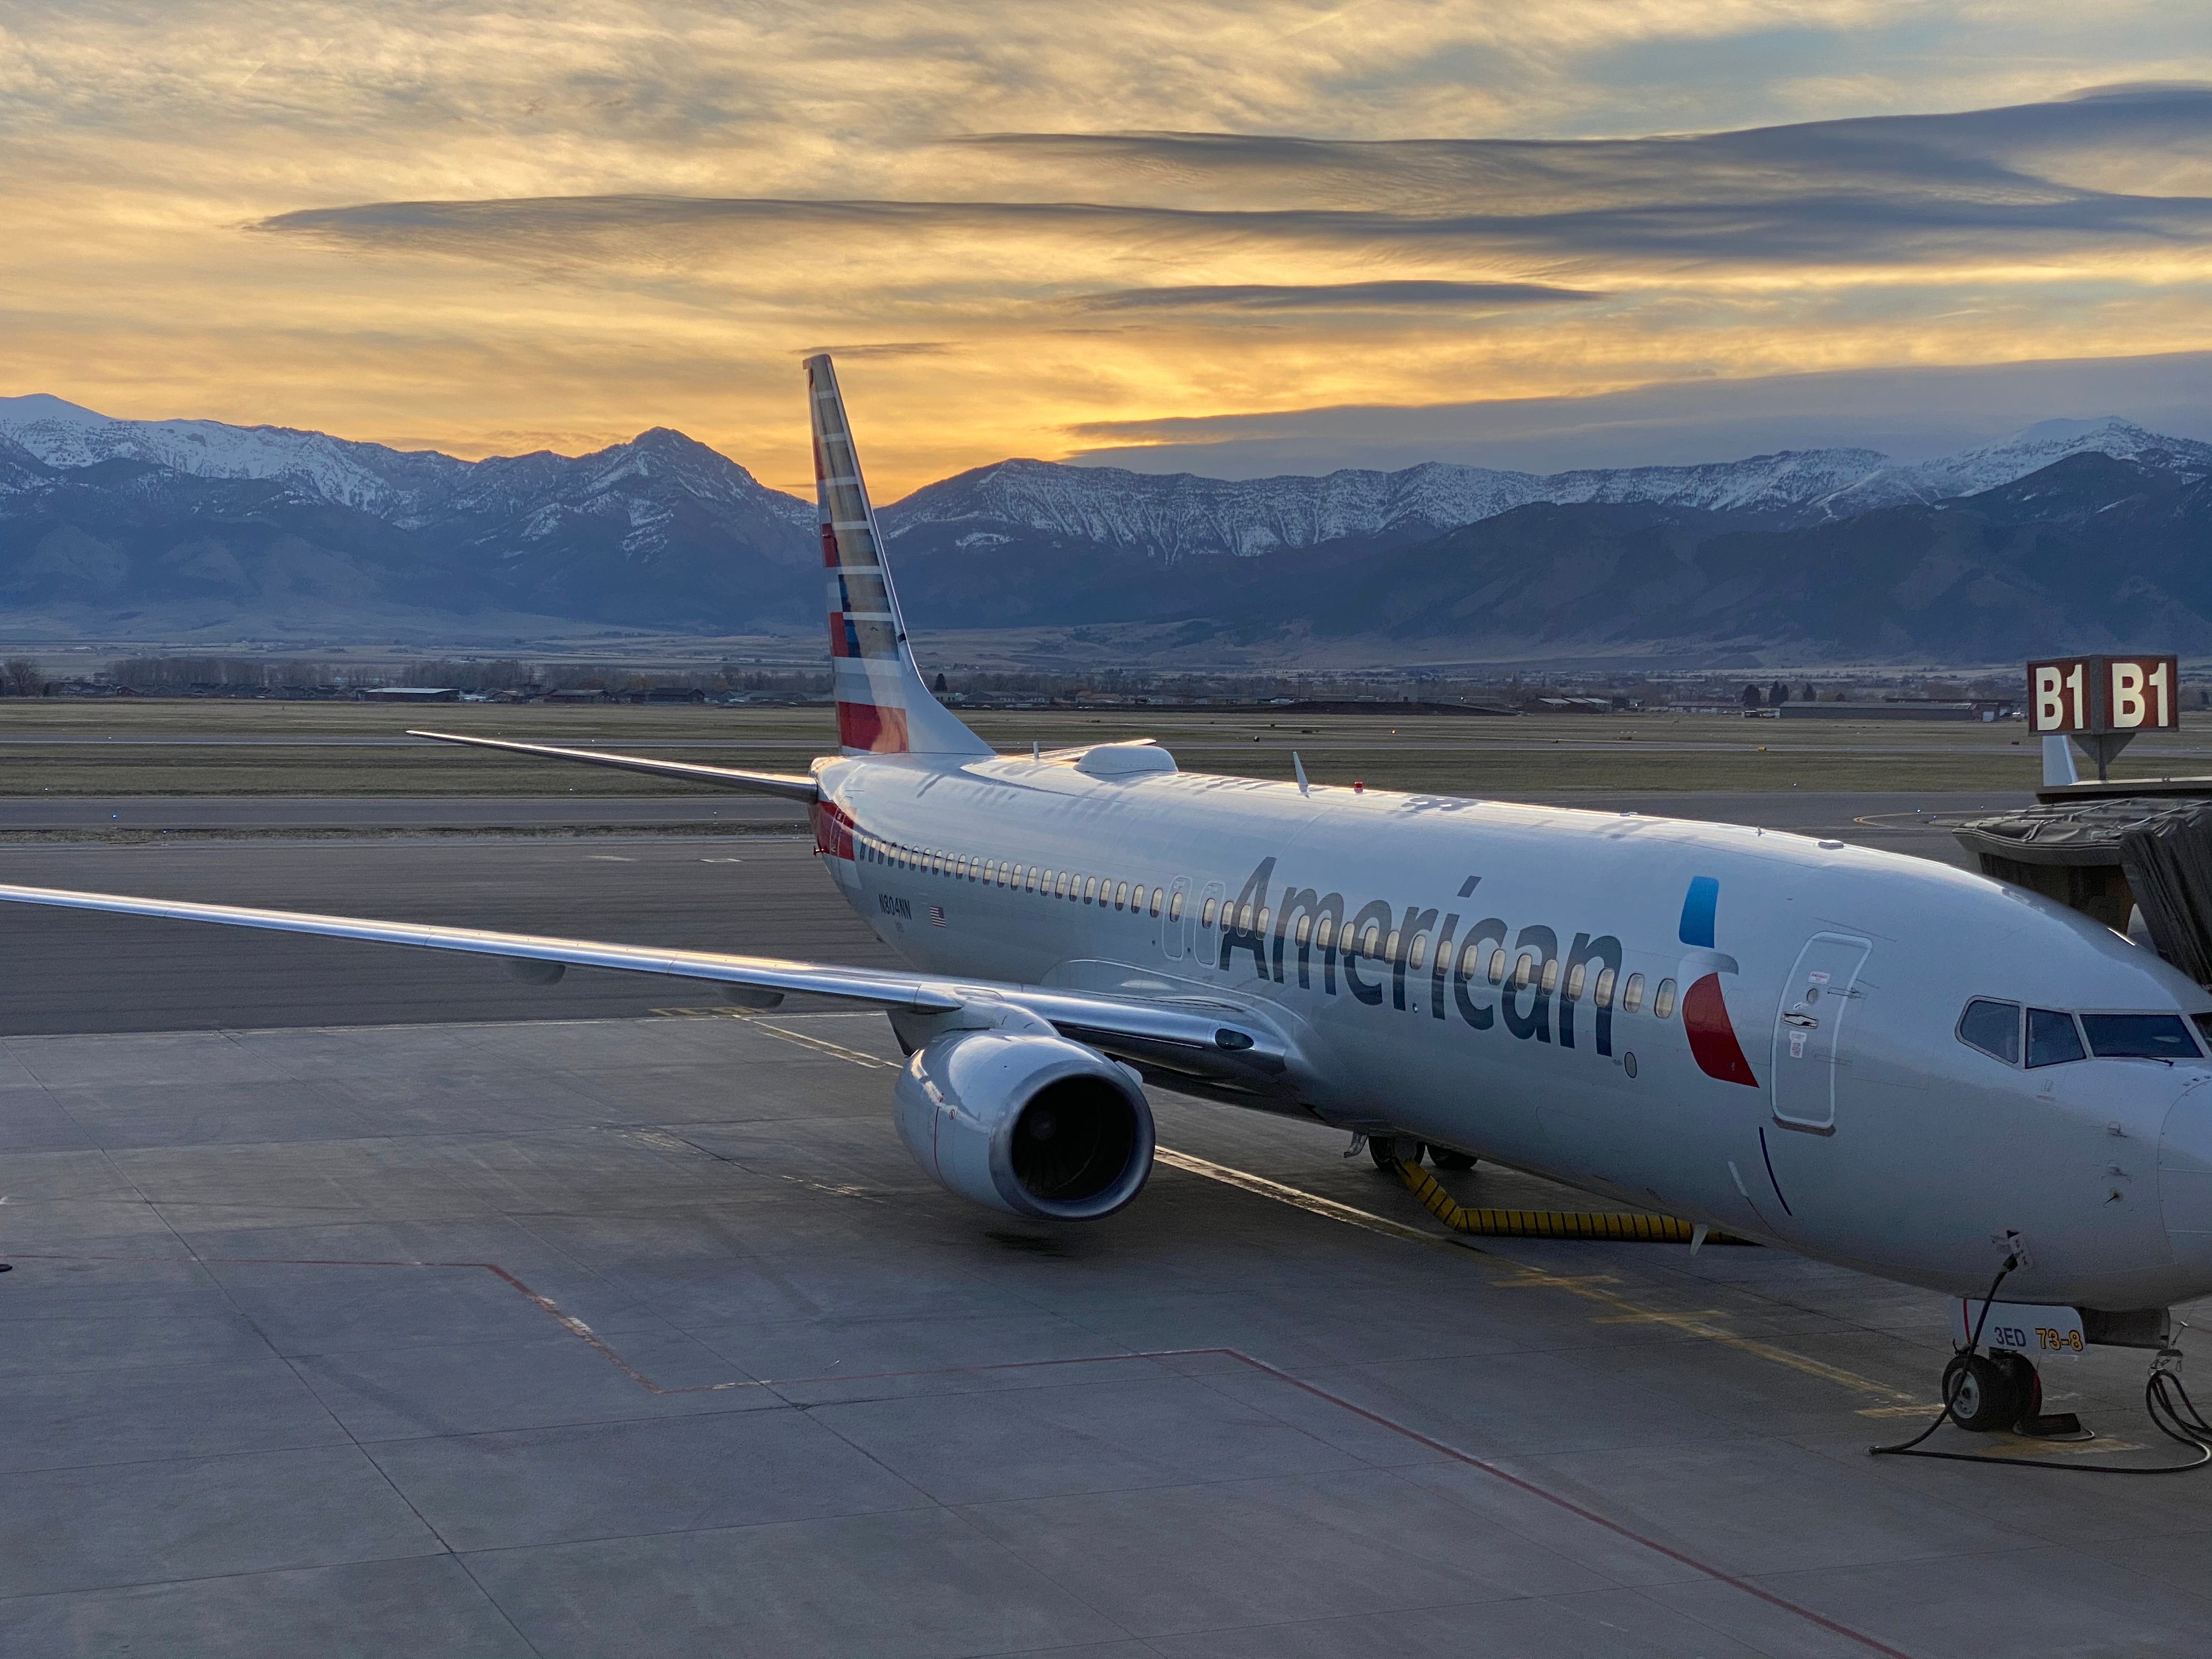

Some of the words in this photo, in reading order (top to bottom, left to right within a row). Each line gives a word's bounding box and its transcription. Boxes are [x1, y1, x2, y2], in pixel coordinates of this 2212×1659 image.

[2036, 664, 2084, 731] B1
[2112, 663, 2169, 728] B1
[878, 894, 912, 921] N804NN
[1220, 857, 1622, 1057] American
[1994, 1326, 2027, 1347] 3ED
[2035, 1328, 2083, 1352] 73-8
